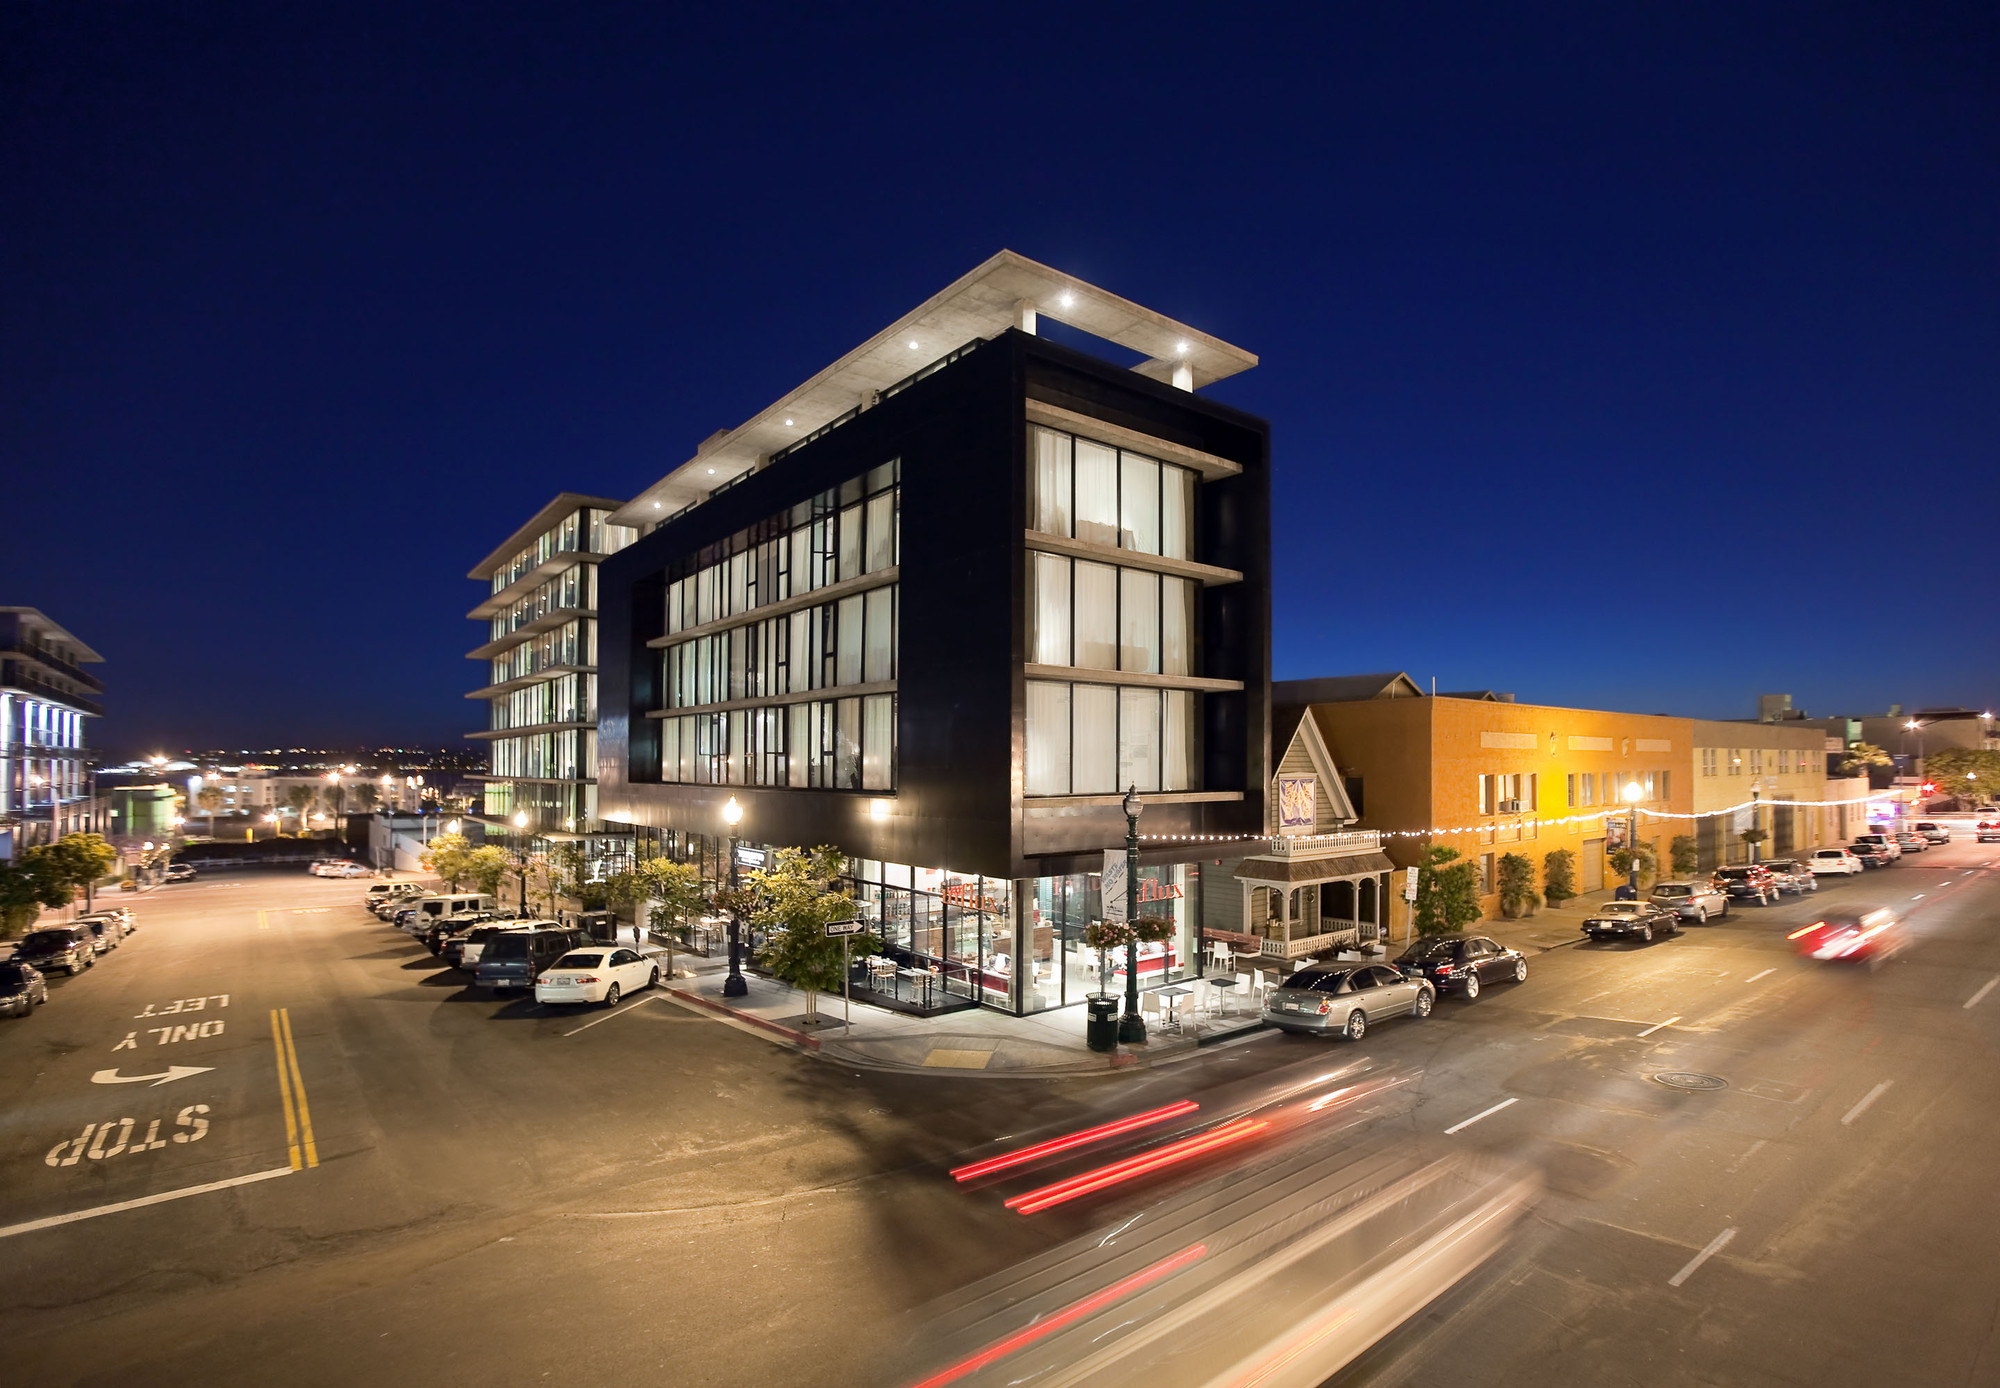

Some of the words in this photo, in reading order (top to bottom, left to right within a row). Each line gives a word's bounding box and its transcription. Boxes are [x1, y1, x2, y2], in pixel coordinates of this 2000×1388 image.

[134, 994, 230, 1019] LEFT
[111, 1020, 225, 1052] ONLY
[45, 1104, 210, 1167] STOP
